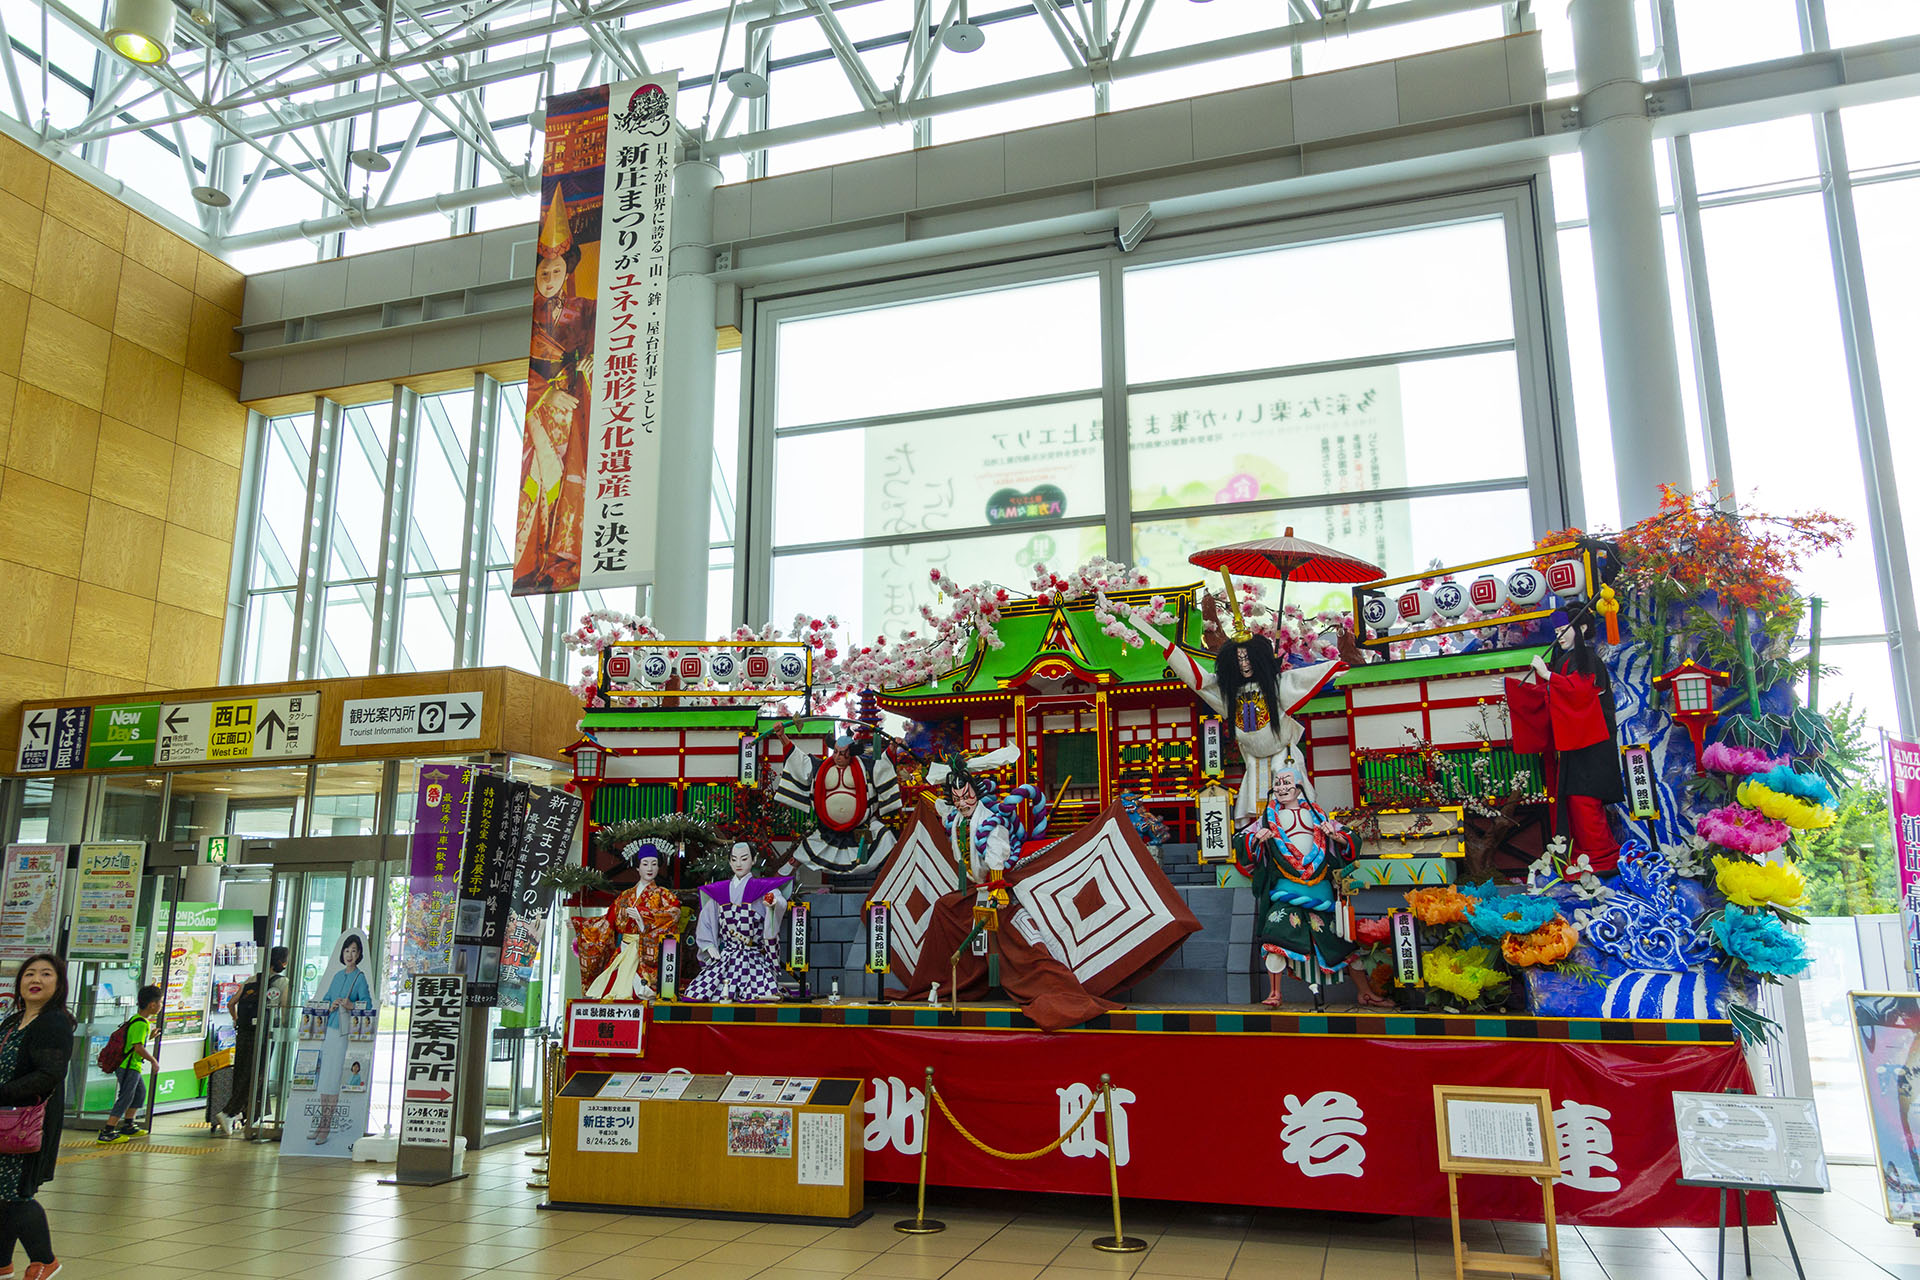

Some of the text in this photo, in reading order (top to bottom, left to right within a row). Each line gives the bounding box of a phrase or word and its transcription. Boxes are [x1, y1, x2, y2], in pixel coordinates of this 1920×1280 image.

[641, 142, 670, 434] 日本が世界に誇る「山・鉾・屋台行事」として
[592, 143, 650, 574] 新庄まつりがユネスコ無形文化遺産に決定
[109, 710, 142, 726] New
[215, 705, 253, 728] 西口
[288, 713, 313, 721] タクシー
[350, 705, 416, 724] 観光案内所
[54, 708, 77, 769] そば屋
[106, 726, 140, 741] Days
[211, 731, 252, 745] (正面口)
[350, 726, 413, 737] Tourist Information
[212, 747, 248, 757] West Exit
[285, 741, 299, 749] バス
[428, 787, 441, 803] 祭
[1203, 810, 1225, 850] 大福帳
[93, 855, 131, 869] トクだ値
[408, 977, 462, 1082] 観光案内所
[159, 1079, 175, 1091] JR
[583, 1114, 635, 1128] 新庄まつり
